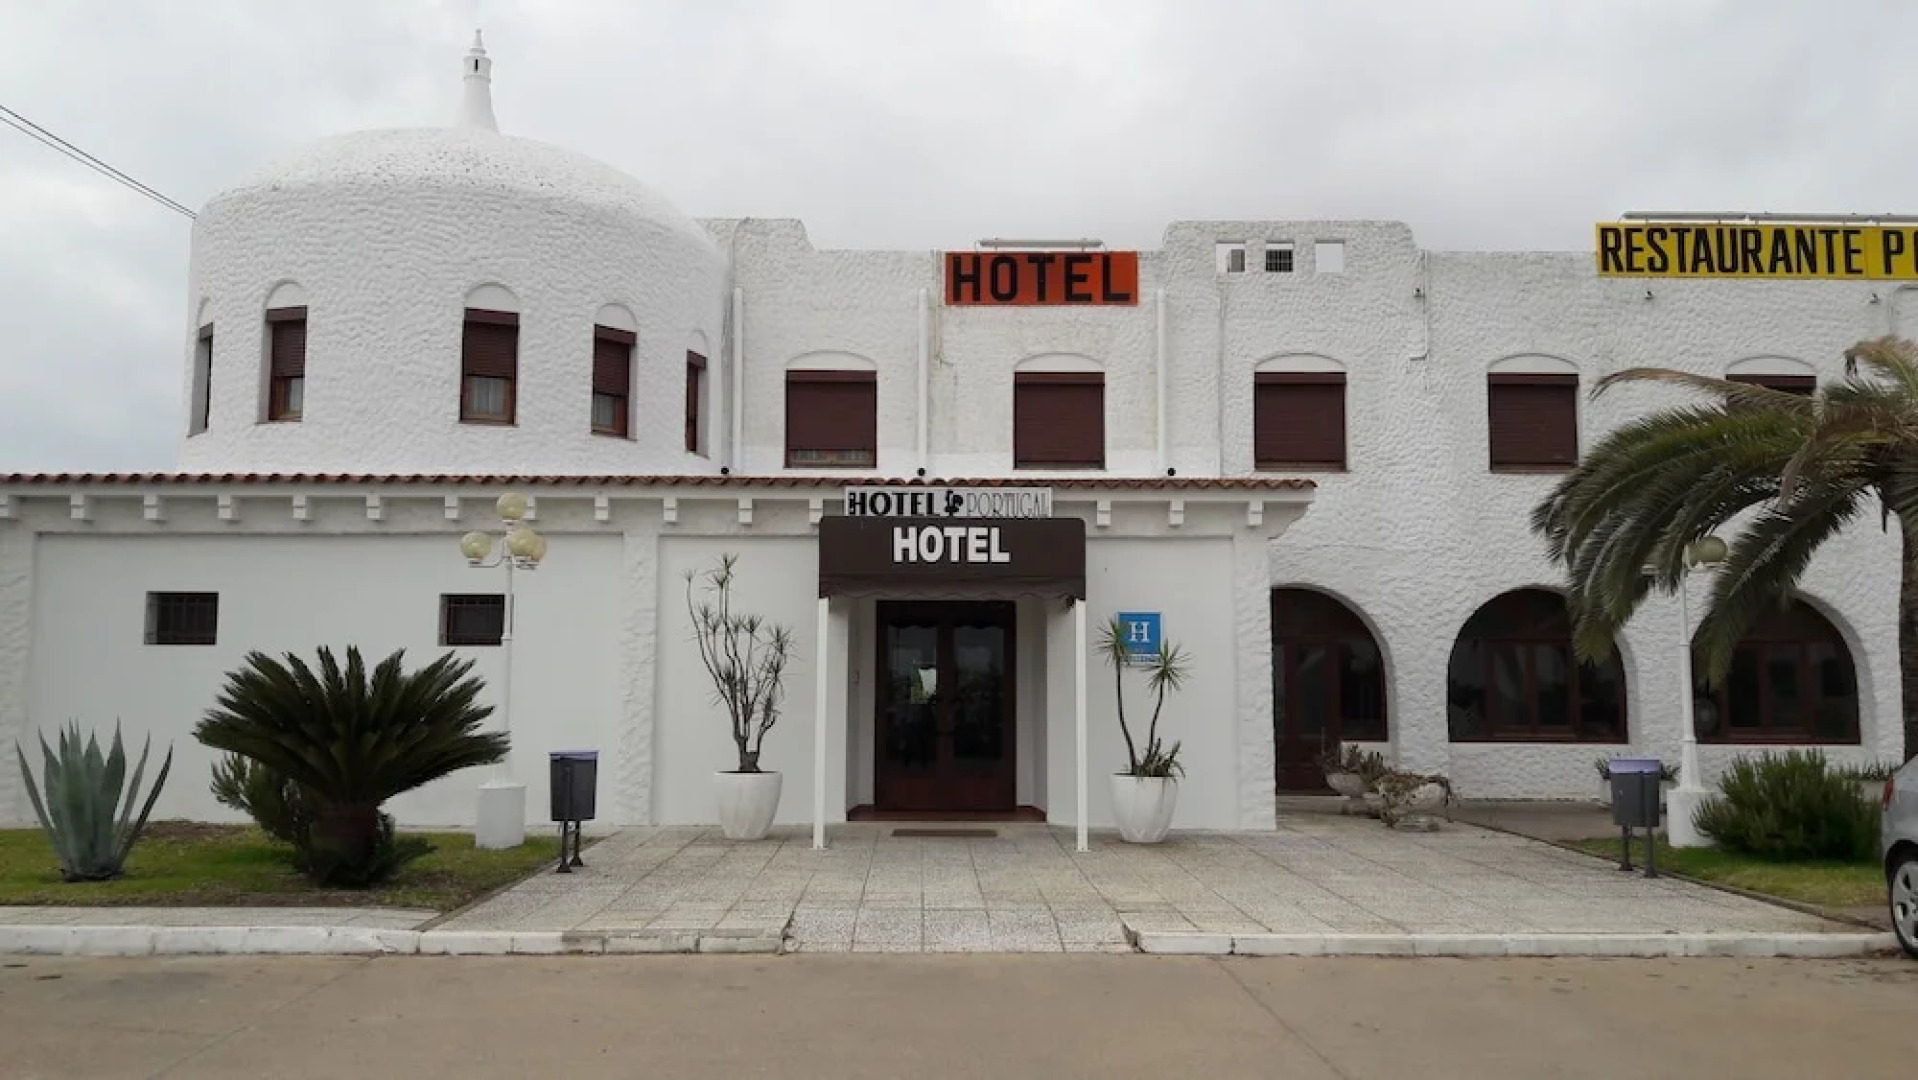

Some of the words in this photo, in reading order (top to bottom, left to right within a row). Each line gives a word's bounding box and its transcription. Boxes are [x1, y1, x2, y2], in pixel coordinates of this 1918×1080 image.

[1600, 227, 1864, 275] RESTAURANTE
[1882, 229, 1918, 275] P
[952, 256, 1131, 302] HOTEL
[849, 491, 941, 517] HOTEL
[966, 492, 1048, 518] PORTUGAL
[892, 526, 1010, 563] HOTEL
[1128, 621, 1150, 643] H
